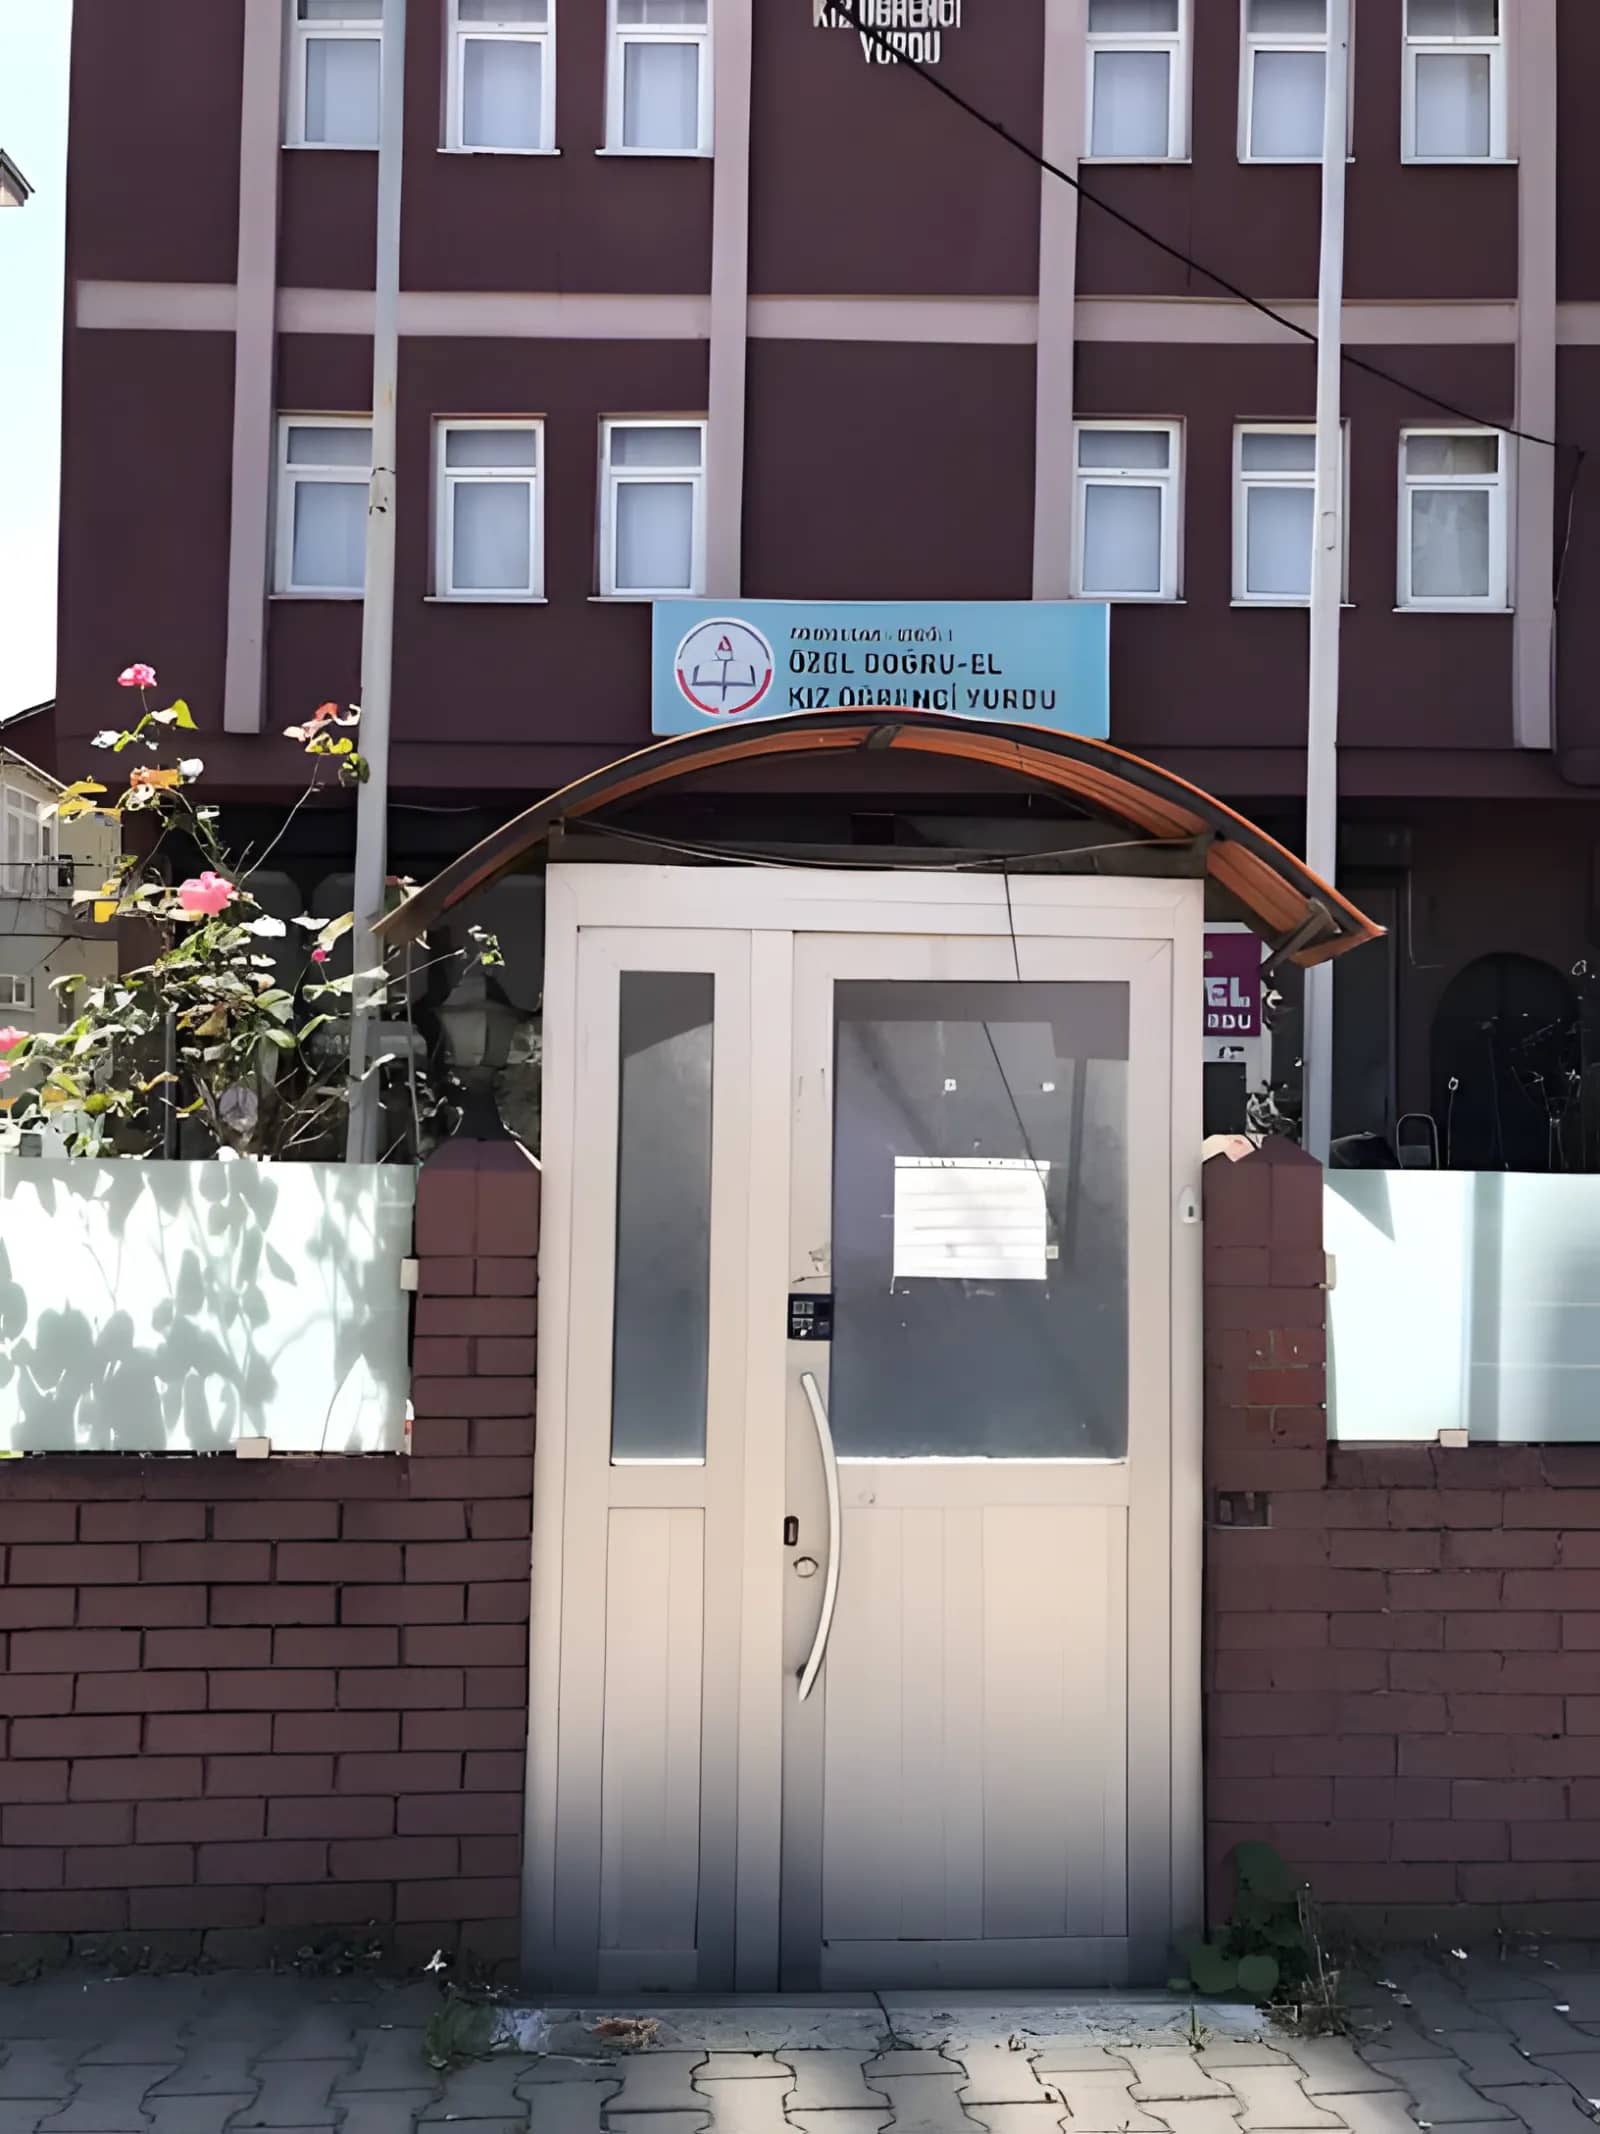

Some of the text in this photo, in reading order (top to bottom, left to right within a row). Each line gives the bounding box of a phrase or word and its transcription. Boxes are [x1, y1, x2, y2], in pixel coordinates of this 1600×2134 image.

[860, 30, 941, 64] YURDU
[864, 648, 1002, 675] DOĞRU-EL
[788, 686, 830, 710] KIZ
[967, 688, 1056, 710] YURDU
